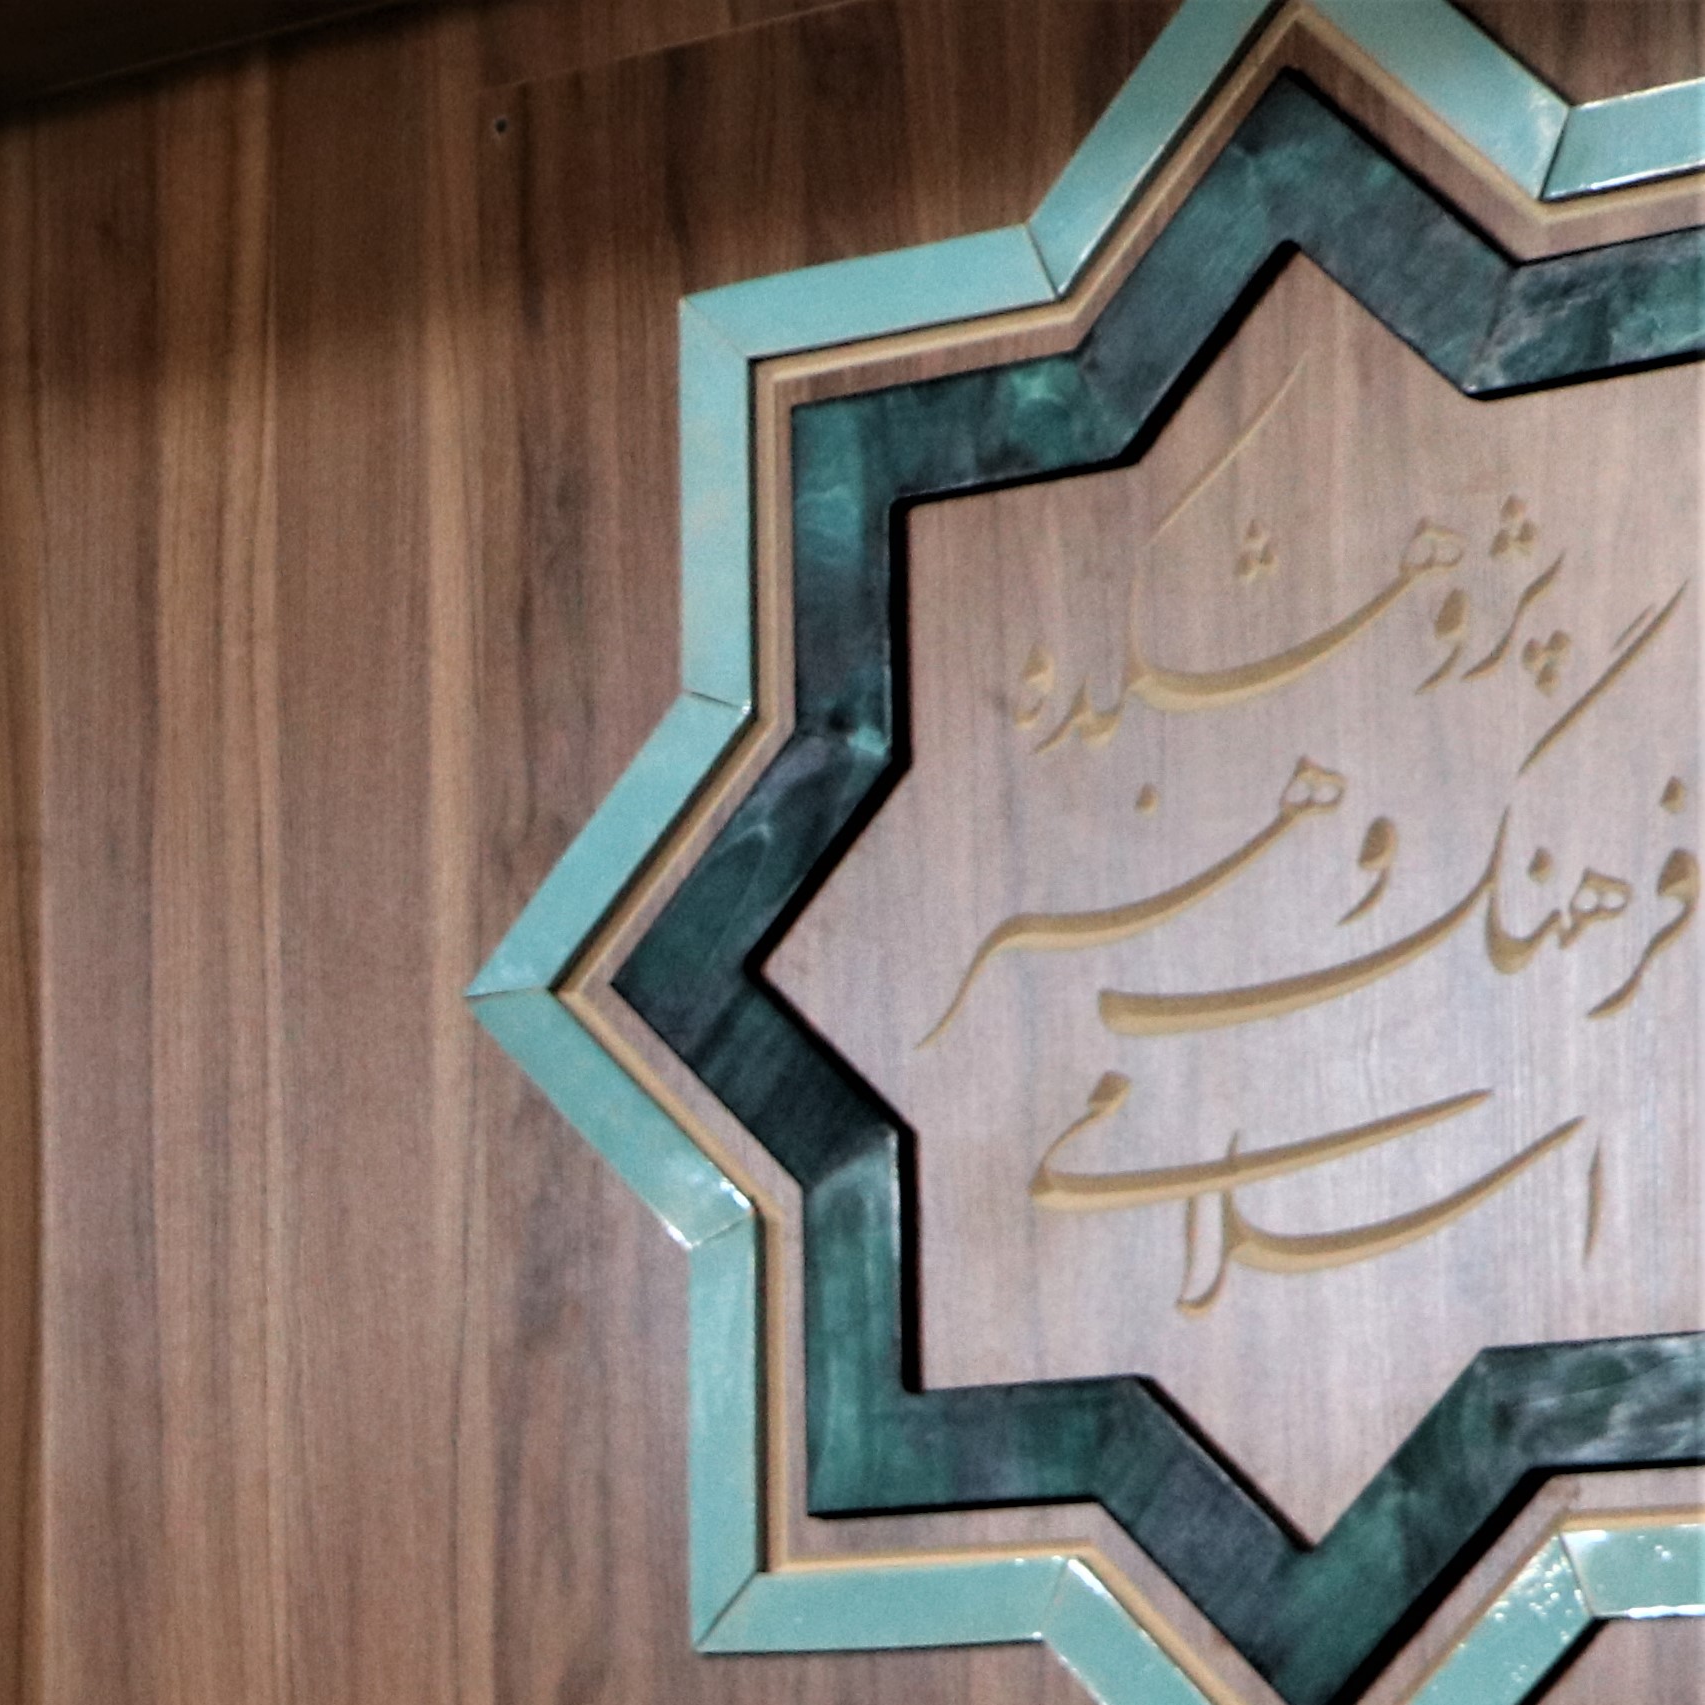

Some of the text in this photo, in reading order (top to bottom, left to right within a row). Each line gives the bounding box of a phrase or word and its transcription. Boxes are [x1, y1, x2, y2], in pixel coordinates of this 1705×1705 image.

[1008, 340, 1570, 756] پژوهشکده
[913, 578, 1698, 1050] فرهنگ و هنر
[1027, 1070, 1602, 1316] اسلامی
